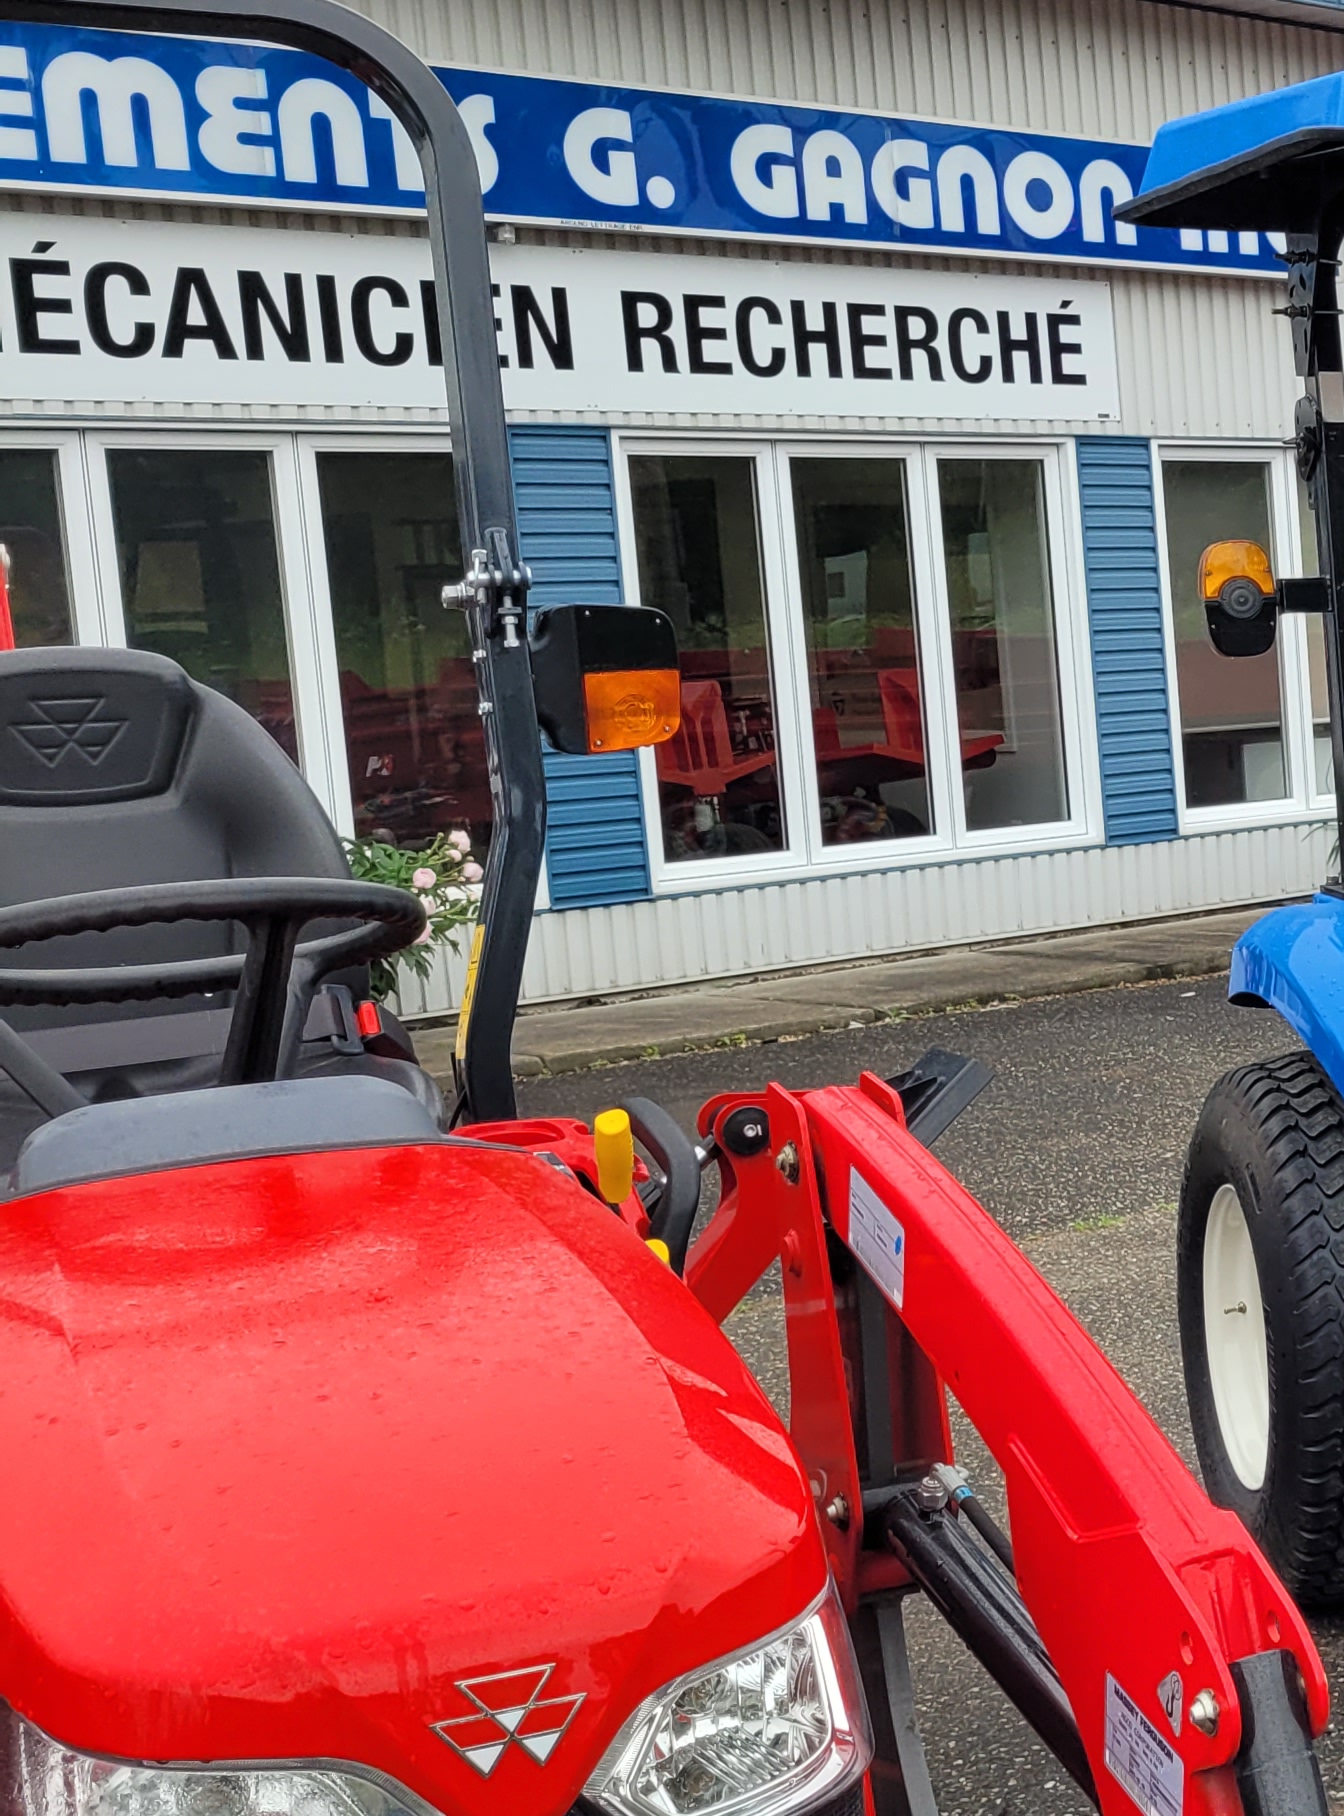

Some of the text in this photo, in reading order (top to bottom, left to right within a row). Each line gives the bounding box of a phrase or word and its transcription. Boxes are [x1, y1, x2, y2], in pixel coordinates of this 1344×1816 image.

[563, 107, 676, 209] G.
[730, 124, 1137, 246] GAGNON
[0, 241, 1087, 386] ÉCANICIN RECHERCHÉ
